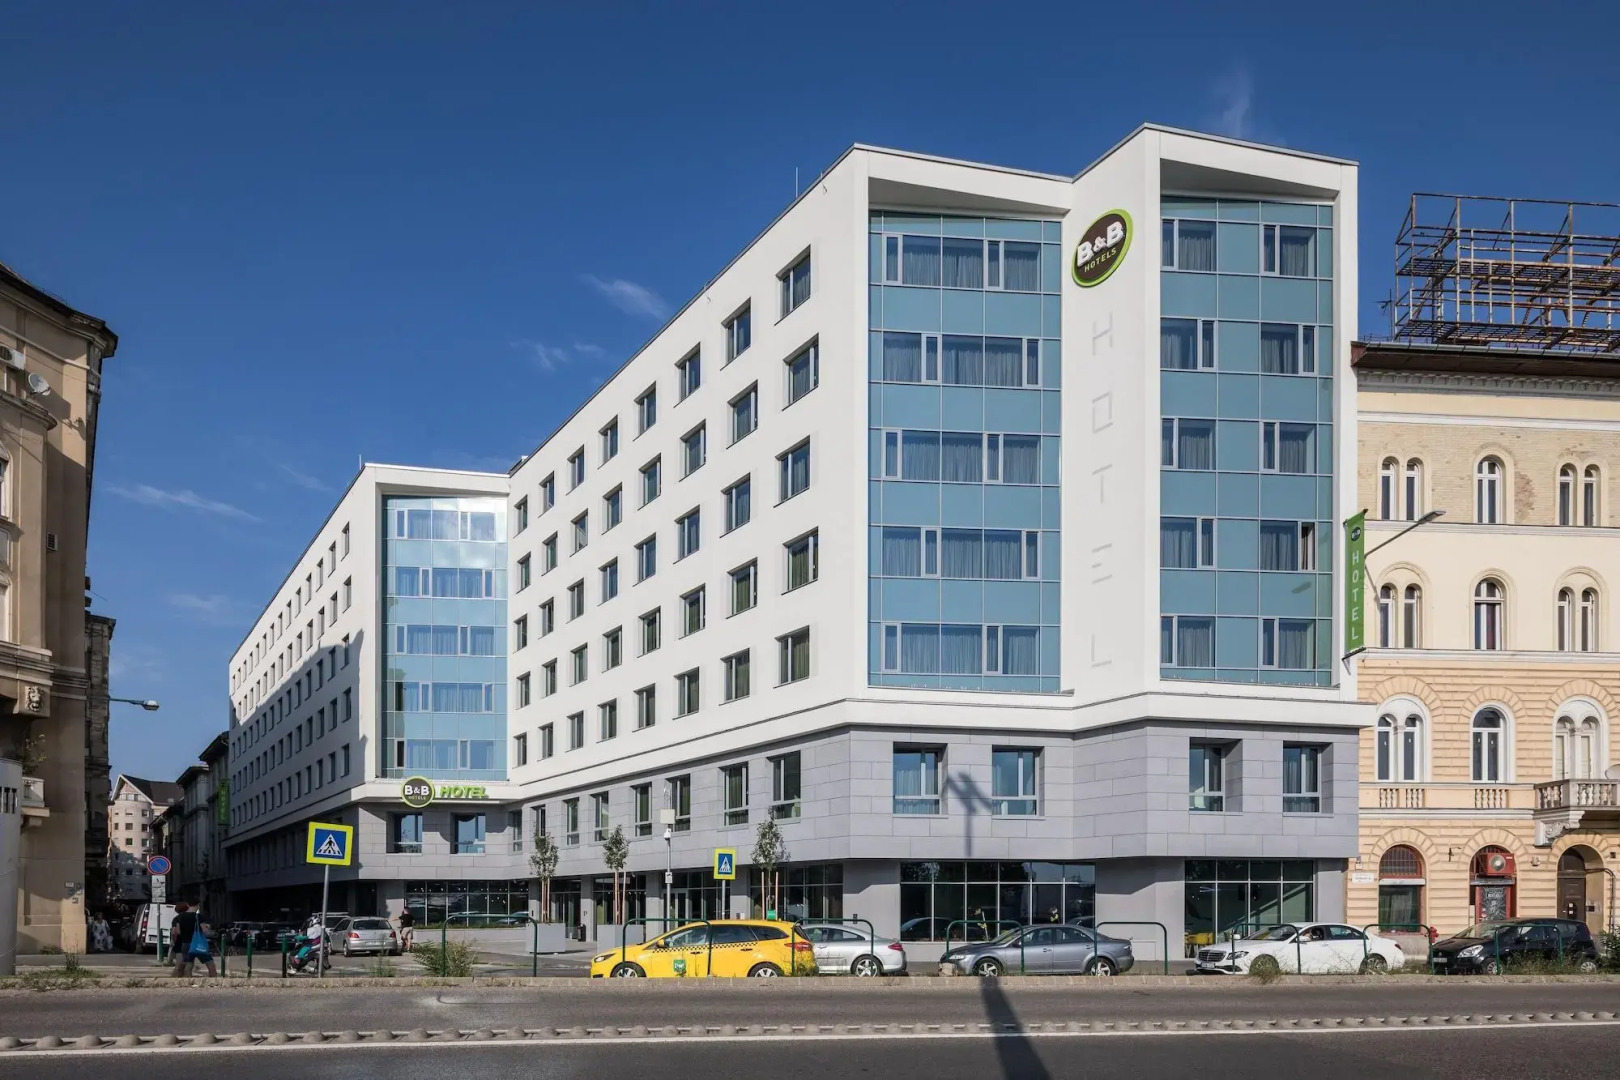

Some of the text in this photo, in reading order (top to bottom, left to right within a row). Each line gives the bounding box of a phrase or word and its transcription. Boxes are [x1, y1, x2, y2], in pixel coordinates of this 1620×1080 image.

[1077, 221, 1124, 267] B&B
[1084, 247, 1117, 272] HOTELS
[1091, 311, 1113, 668] HOTEL
[404, 785, 487, 798] B&B HOTEL
